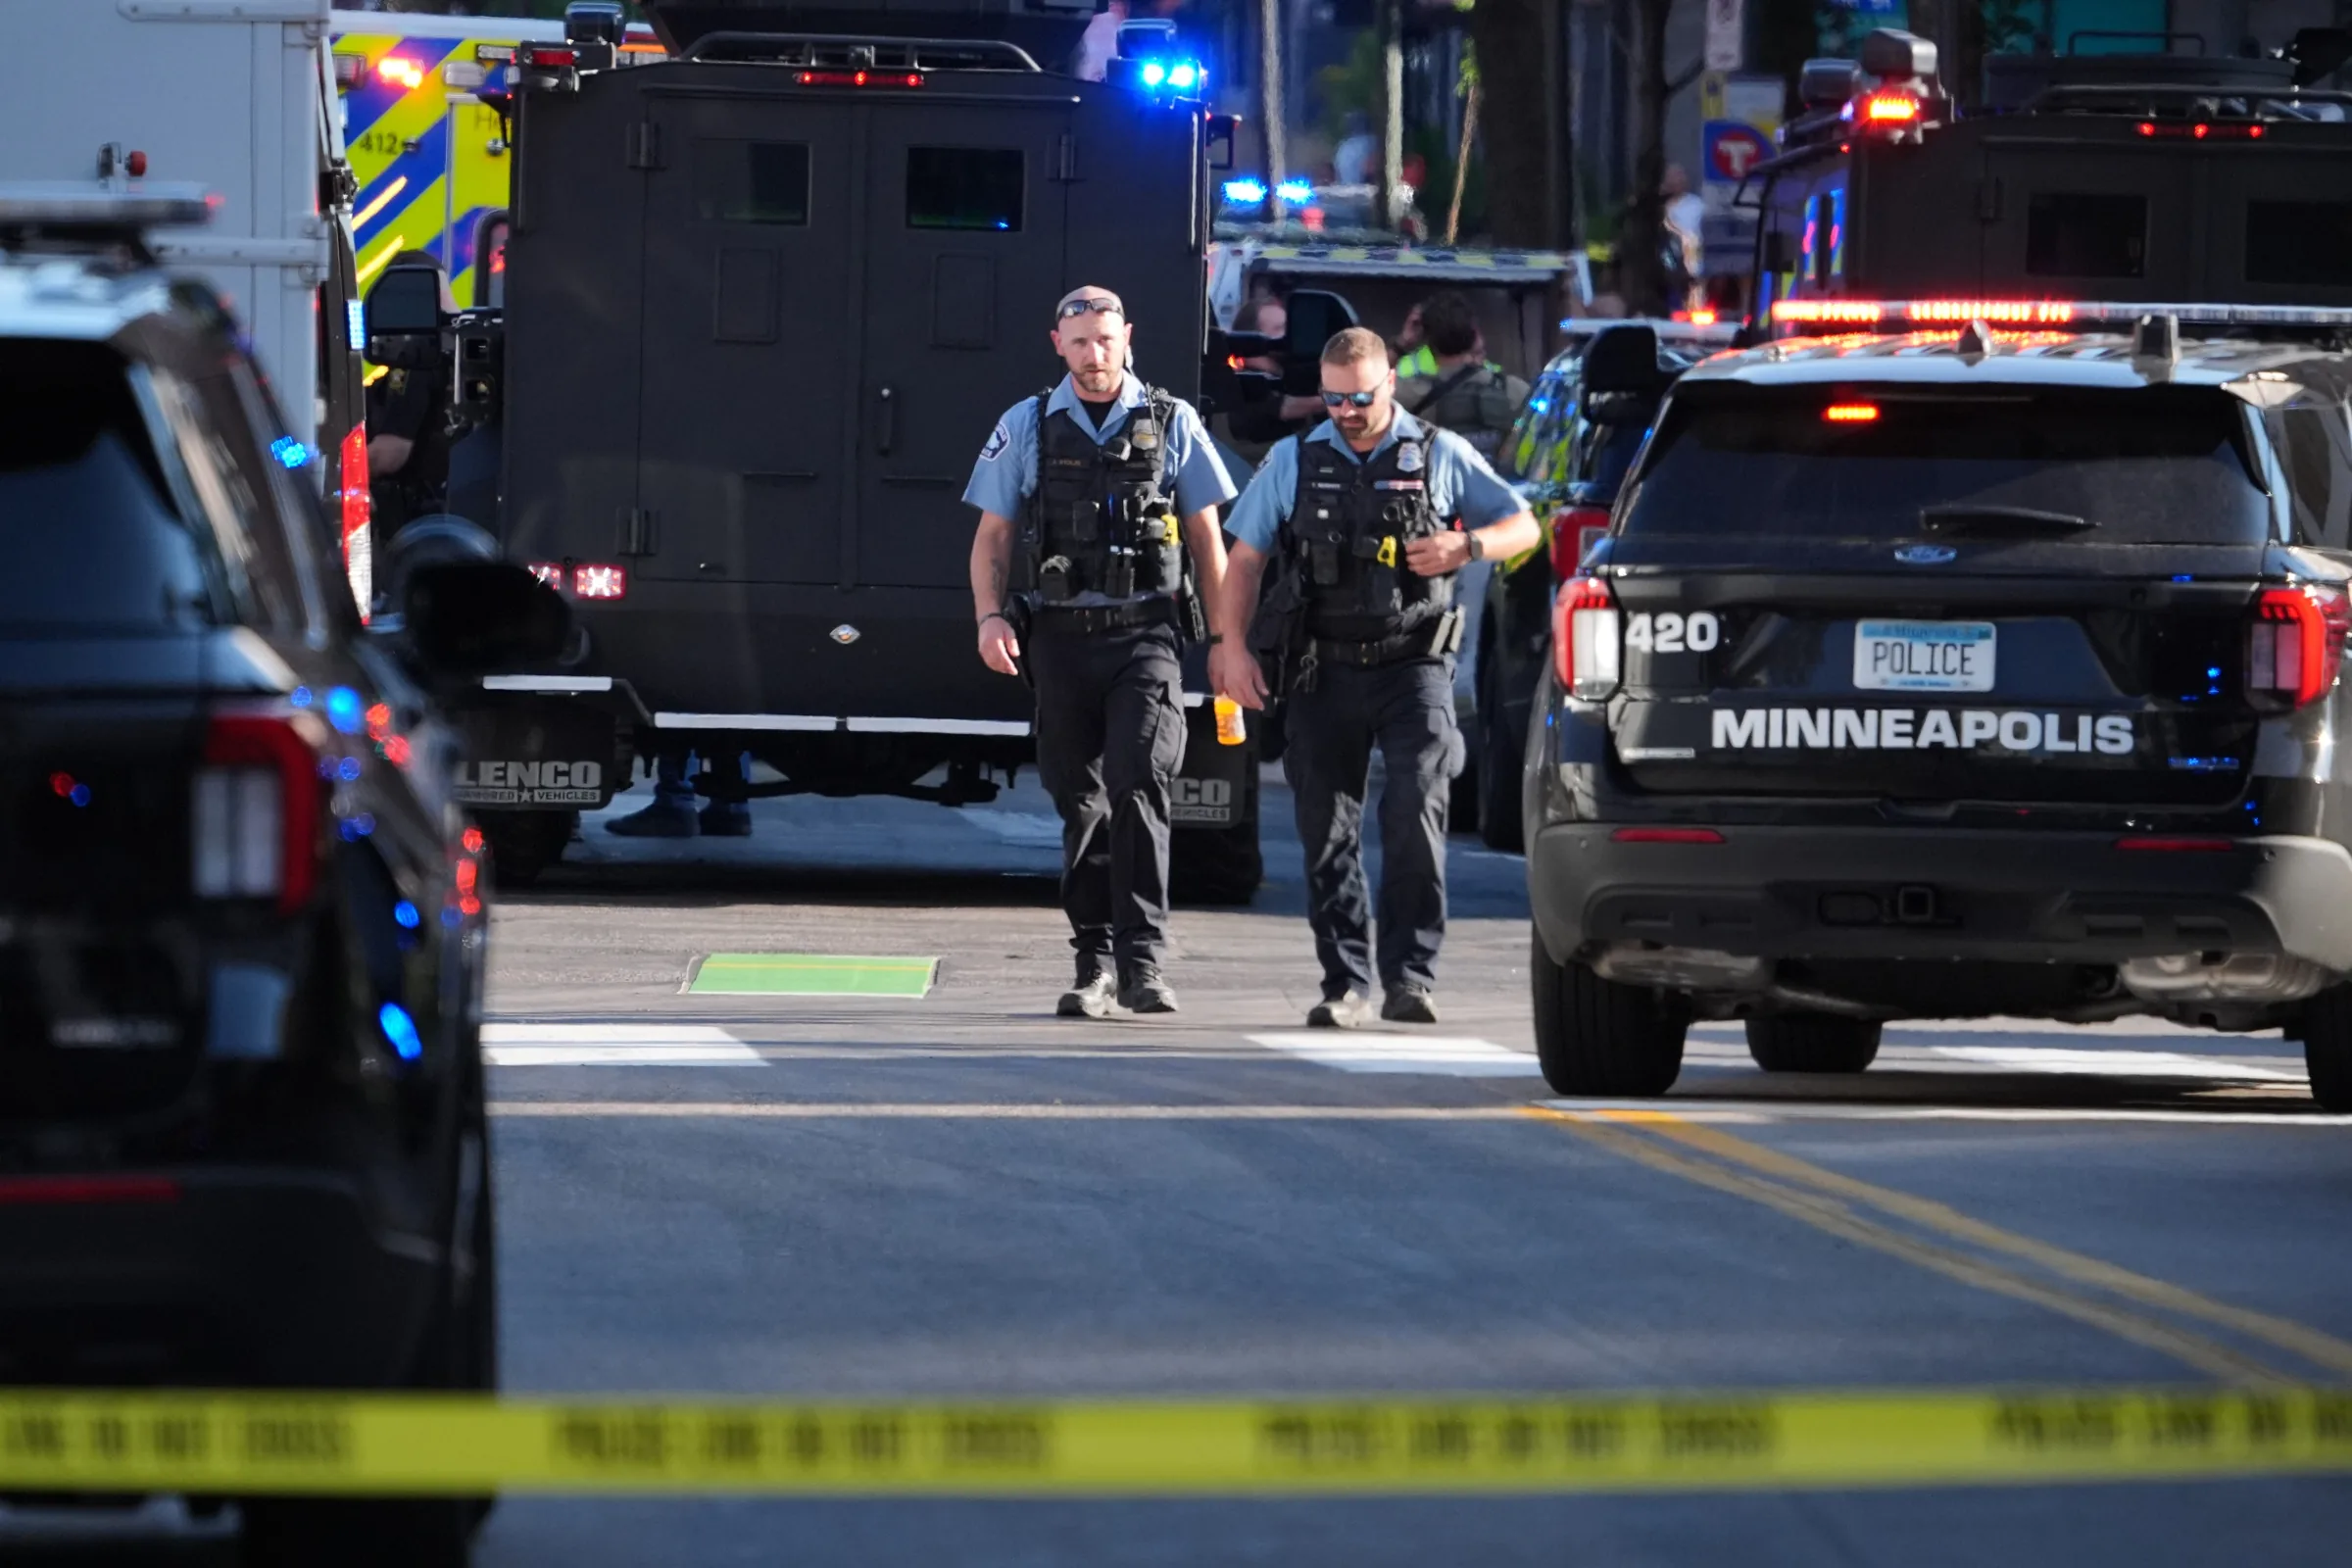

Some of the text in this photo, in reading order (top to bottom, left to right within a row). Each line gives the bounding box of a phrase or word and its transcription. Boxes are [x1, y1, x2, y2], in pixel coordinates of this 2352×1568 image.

[359, 130, 399, 155] 412
[1625, 611, 1719, 654] 420
[1873, 641, 1976, 676] POLICE
[1712, 709, 2134, 755] MINNEAPOLIS
[454, 760, 602, 788] LENCO
[538, 791, 597, 801] VEHICLES
